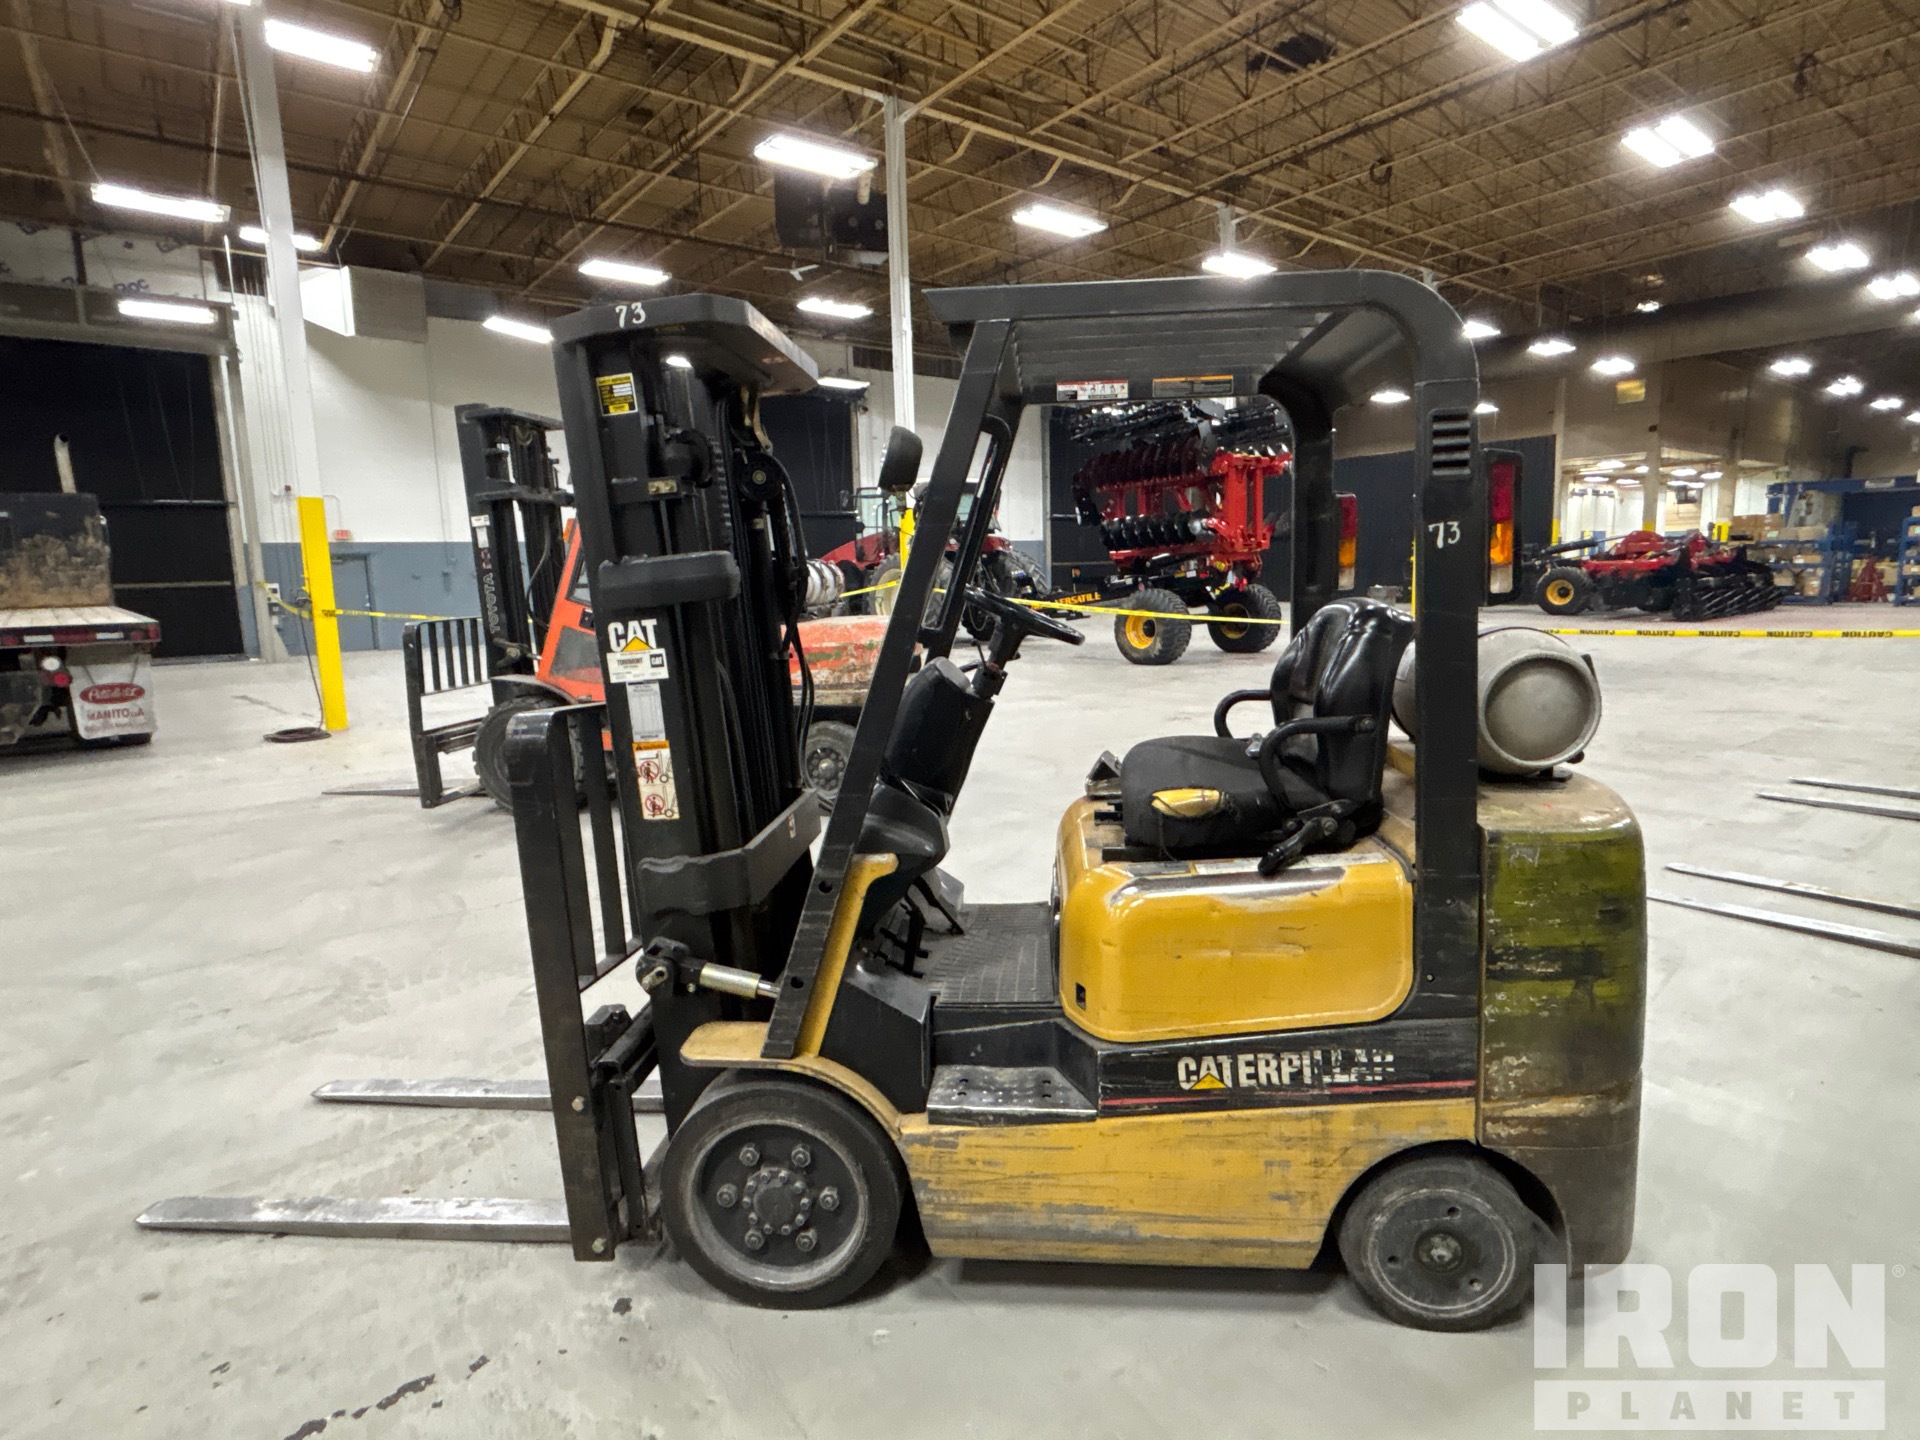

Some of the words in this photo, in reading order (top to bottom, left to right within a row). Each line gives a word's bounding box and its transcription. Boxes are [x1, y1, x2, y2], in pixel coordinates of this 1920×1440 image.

[615, 302, 646, 328] 73
[1428, 521, 1461, 549] 73
[482, 572, 500, 634] TOYOTA
[608, 618, 657, 652] CAT
[651, 656, 663, 665] CAT
